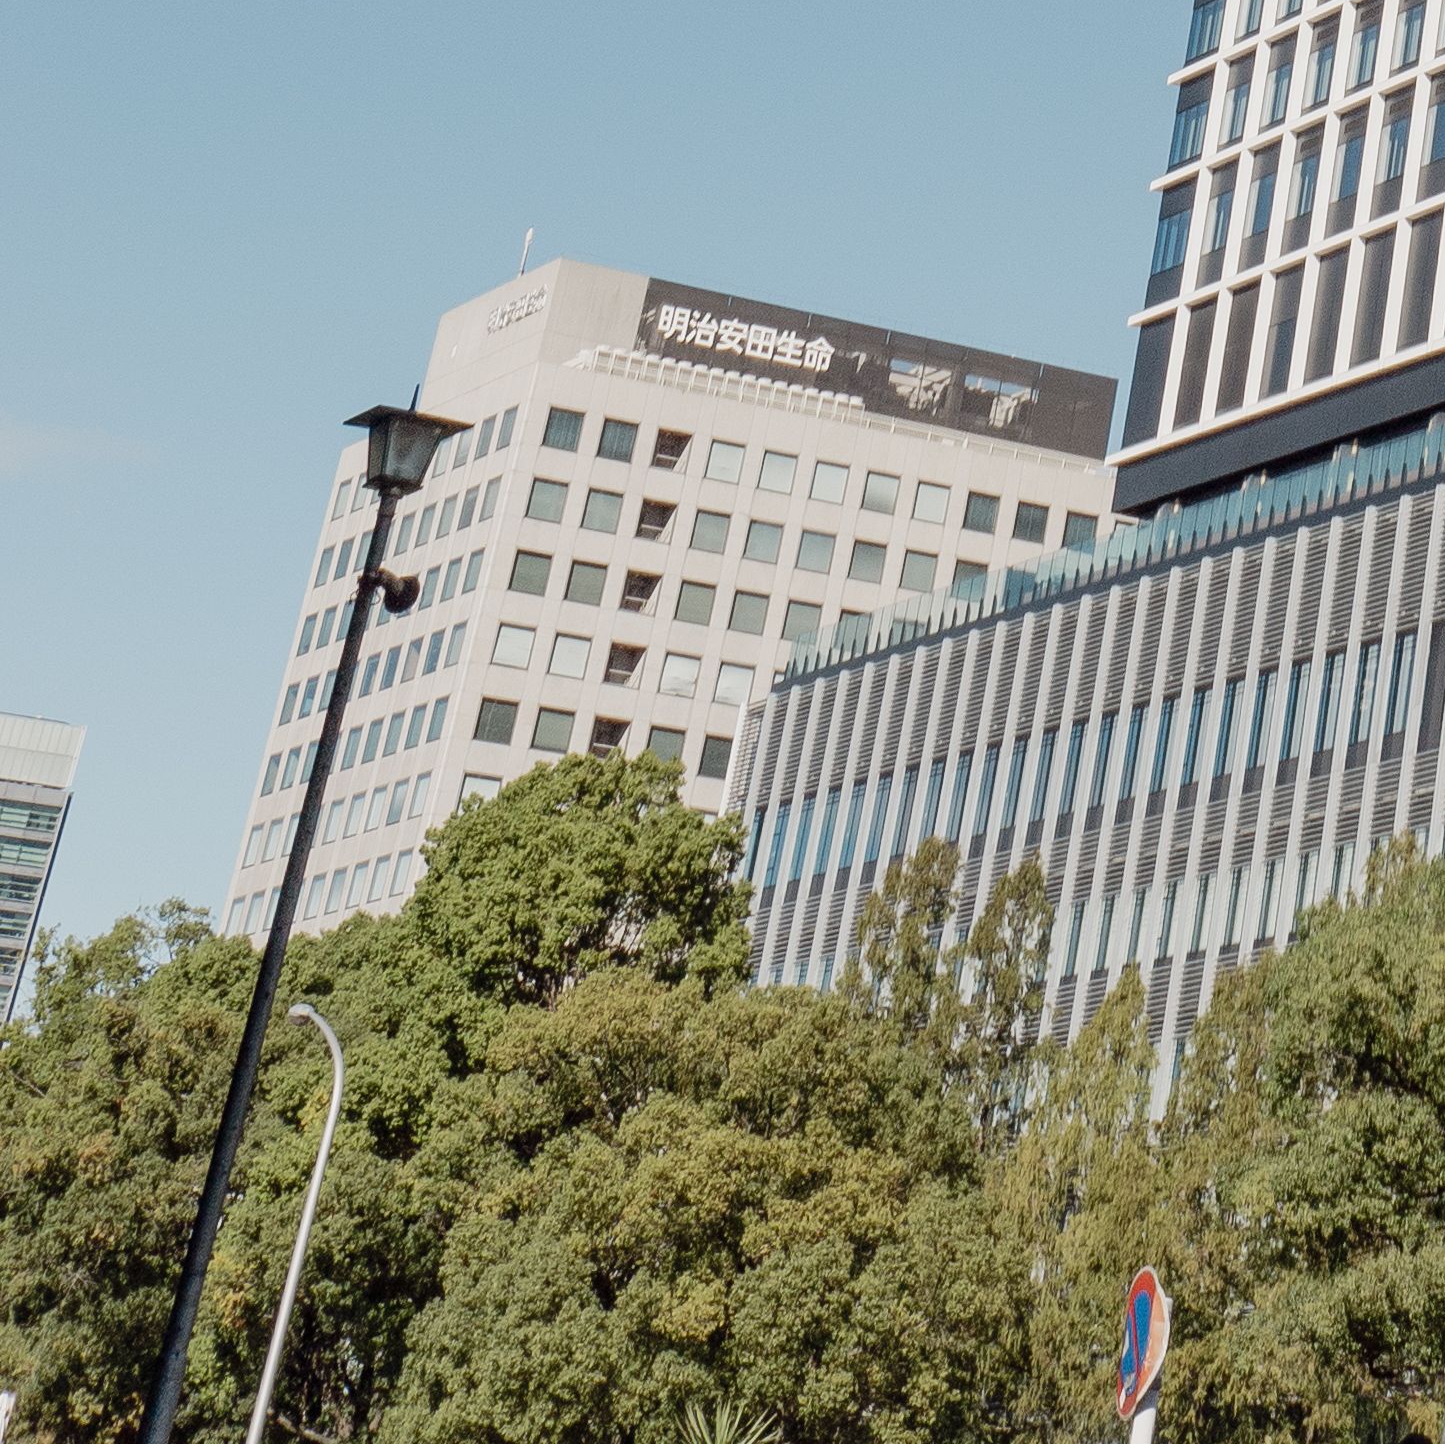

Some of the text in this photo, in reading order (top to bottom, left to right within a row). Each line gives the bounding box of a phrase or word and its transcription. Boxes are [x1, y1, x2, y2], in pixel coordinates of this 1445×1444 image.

[657, 304, 835, 373] 明治安田生命
